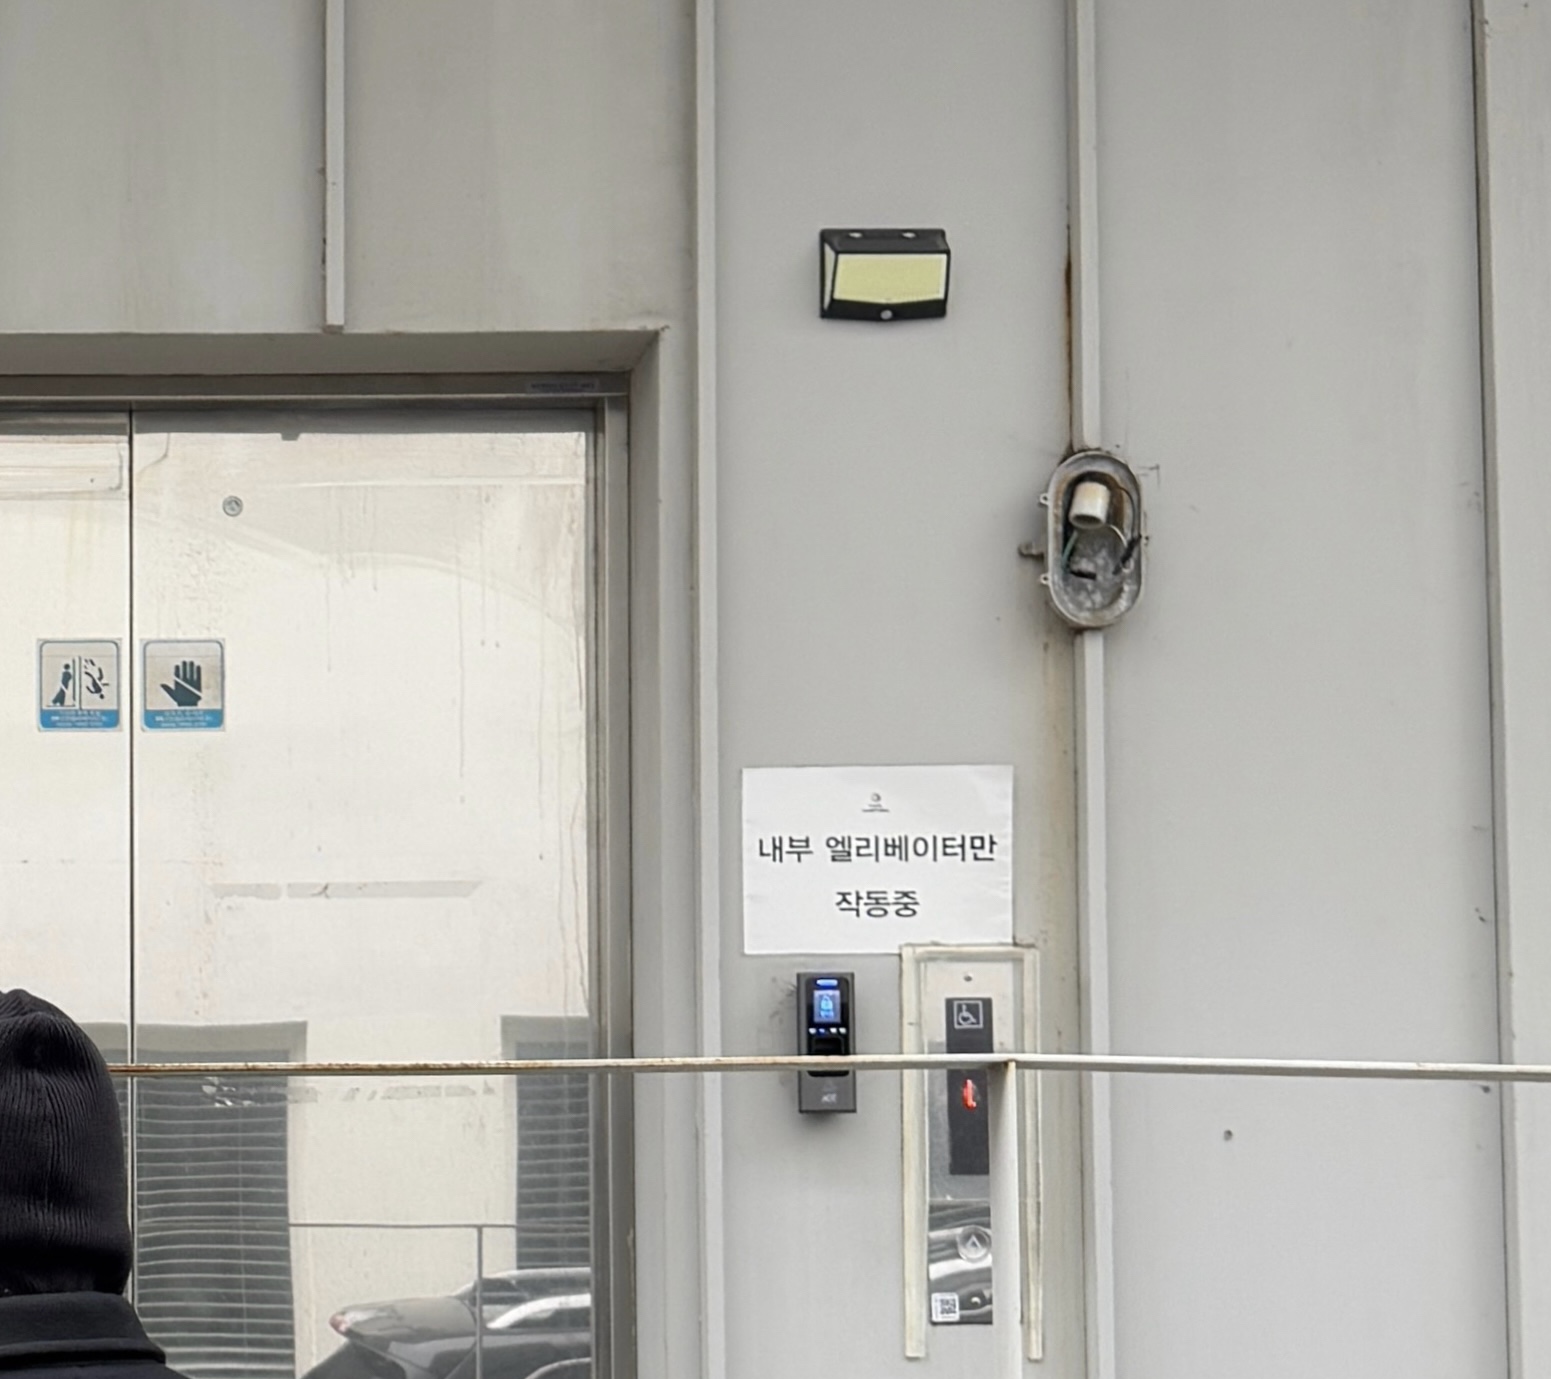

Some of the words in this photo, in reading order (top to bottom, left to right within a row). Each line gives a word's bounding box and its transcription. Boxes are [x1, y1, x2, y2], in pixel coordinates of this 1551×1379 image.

[759, 836, 813, 863] 내부
[825, 834, 998, 863] 엘리베이터만
[835, 890, 920, 918] 작동중
